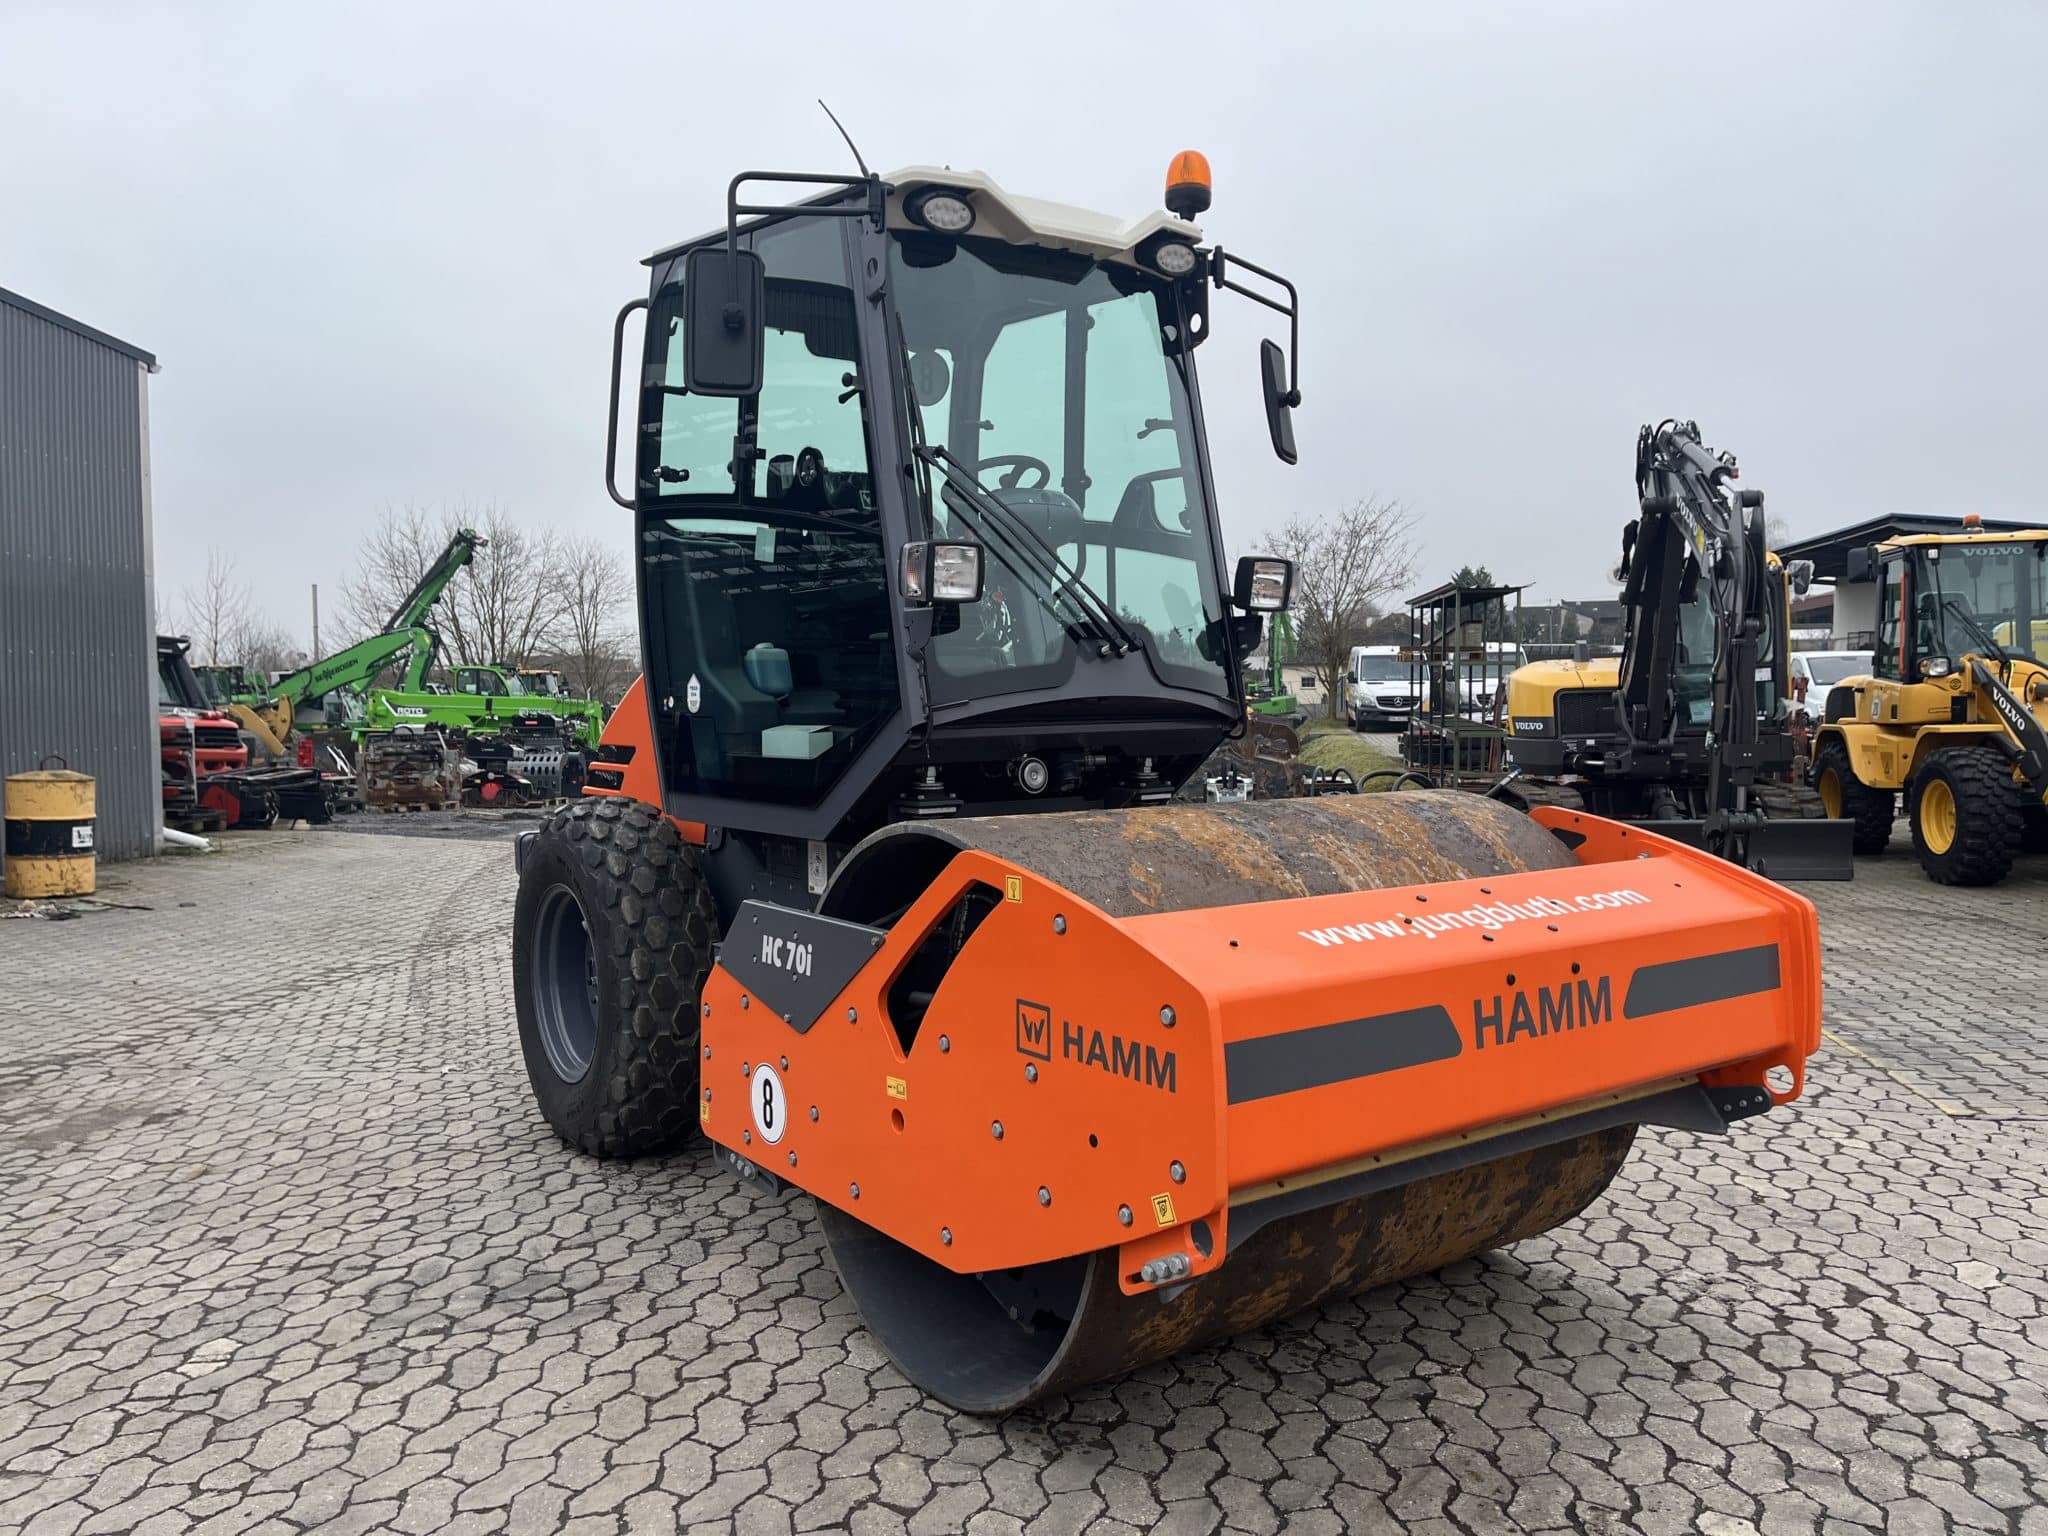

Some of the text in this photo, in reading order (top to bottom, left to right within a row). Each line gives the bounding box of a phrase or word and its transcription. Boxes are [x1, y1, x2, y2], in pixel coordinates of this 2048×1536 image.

[1676, 492, 1697, 537] VOLVO
[1960, 546, 2024, 556] VOLVO
[1515, 722, 1544, 730] VOLVO
[1993, 686, 2025, 730] VOLVO
[1297, 889, 1652, 947] www.jungbluth.com
[761, 934, 813, 977] HC 70i
[1473, 975, 1613, 1051] HAMM
[1063, 1020, 1176, 1093] HAMM
[763, 1078, 773, 1129] 8
